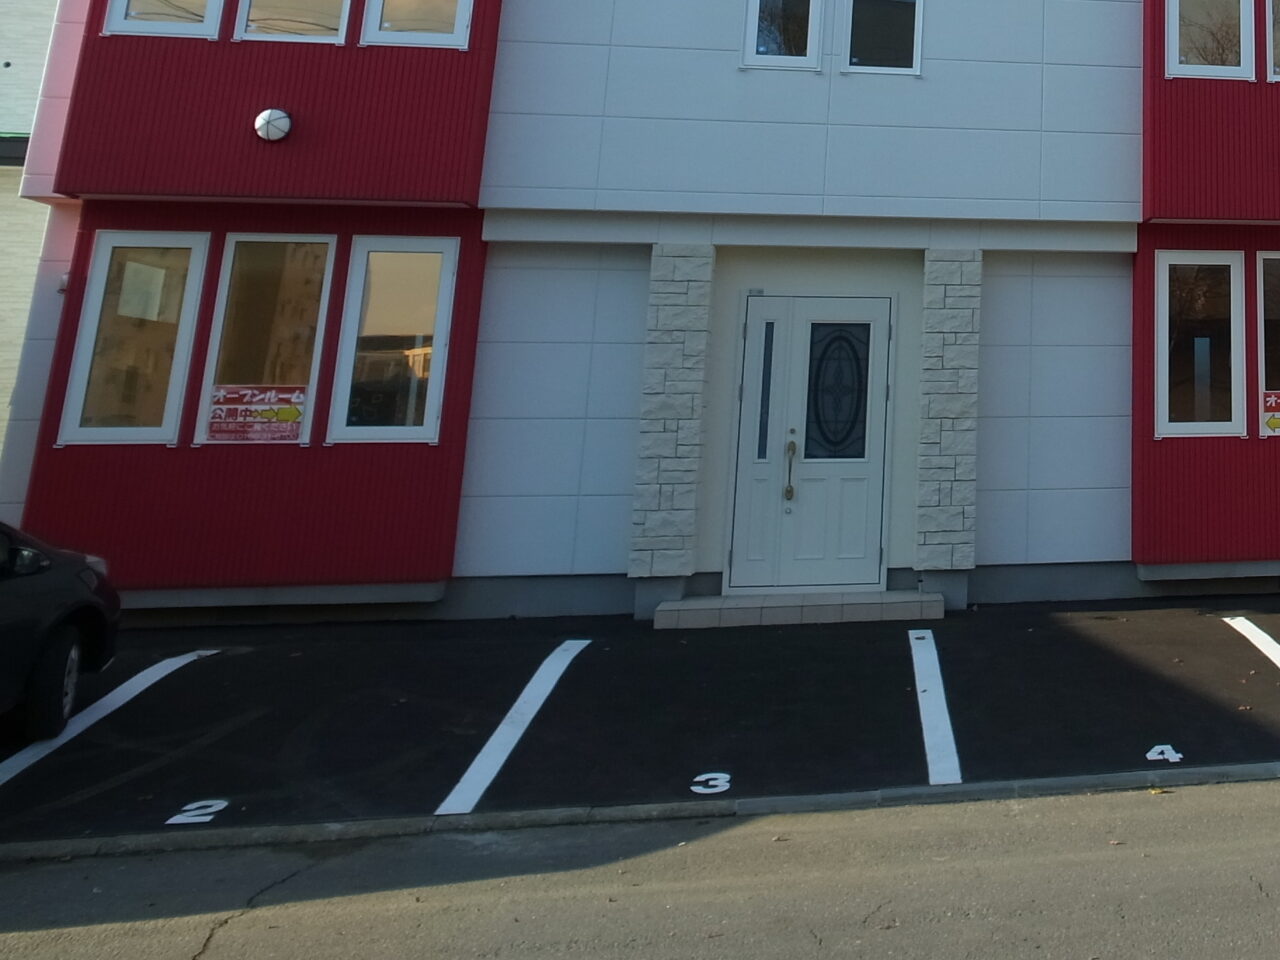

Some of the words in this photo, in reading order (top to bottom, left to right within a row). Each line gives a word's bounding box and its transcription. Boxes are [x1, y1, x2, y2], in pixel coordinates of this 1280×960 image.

[213, 389, 304, 403] オープンルーム
[211, 407, 254, 421] 公開中
[1146, 744, 1184, 763] 4
[690, 772, 731, 794] 3
[165, 799, 229, 825] 2
